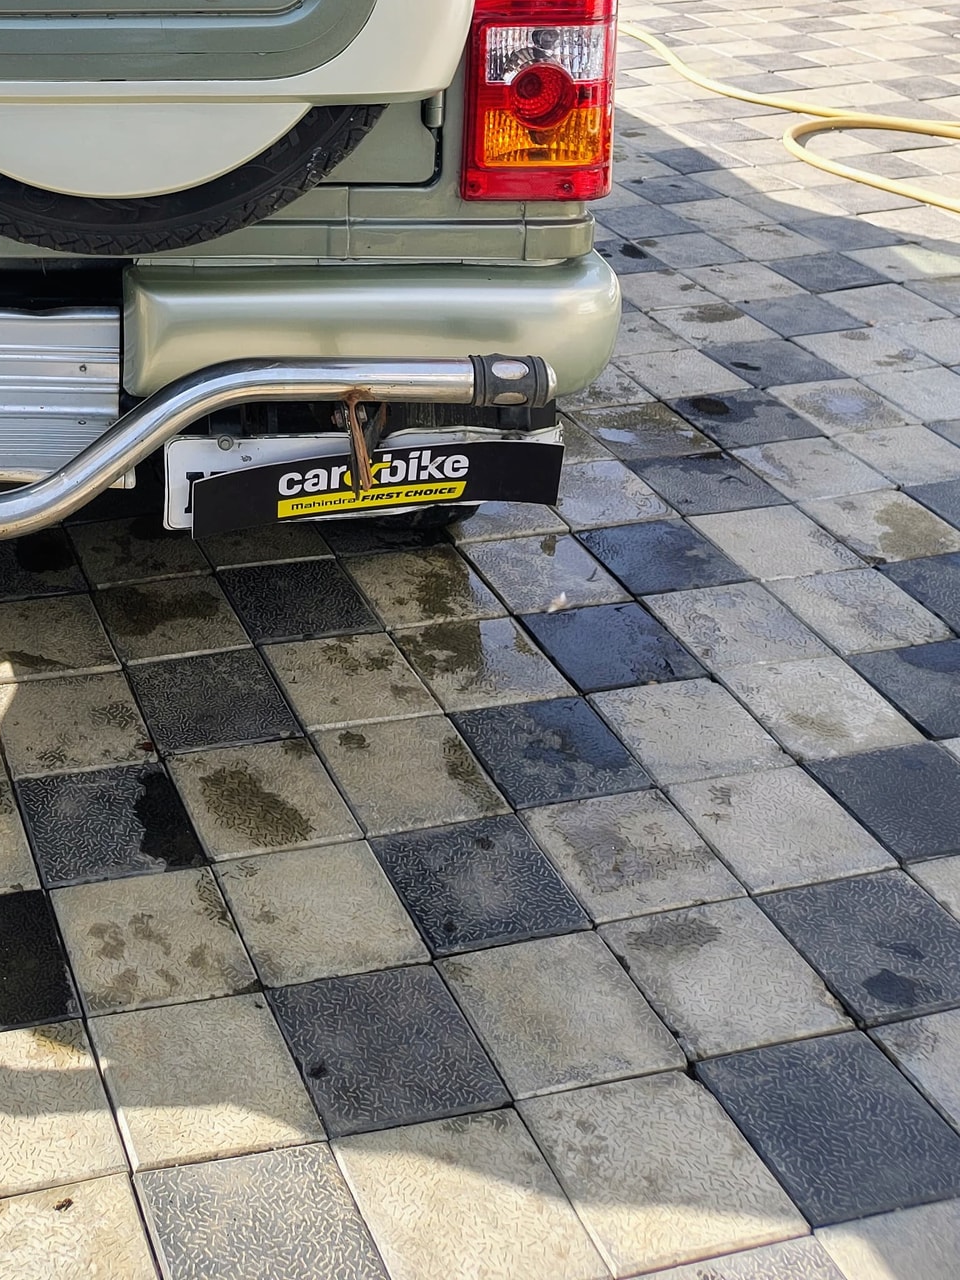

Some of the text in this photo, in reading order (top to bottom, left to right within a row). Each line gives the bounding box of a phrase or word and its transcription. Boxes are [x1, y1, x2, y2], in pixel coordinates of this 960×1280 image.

[291, 487, 458, 511] Mahindra FIRST CHOICE
